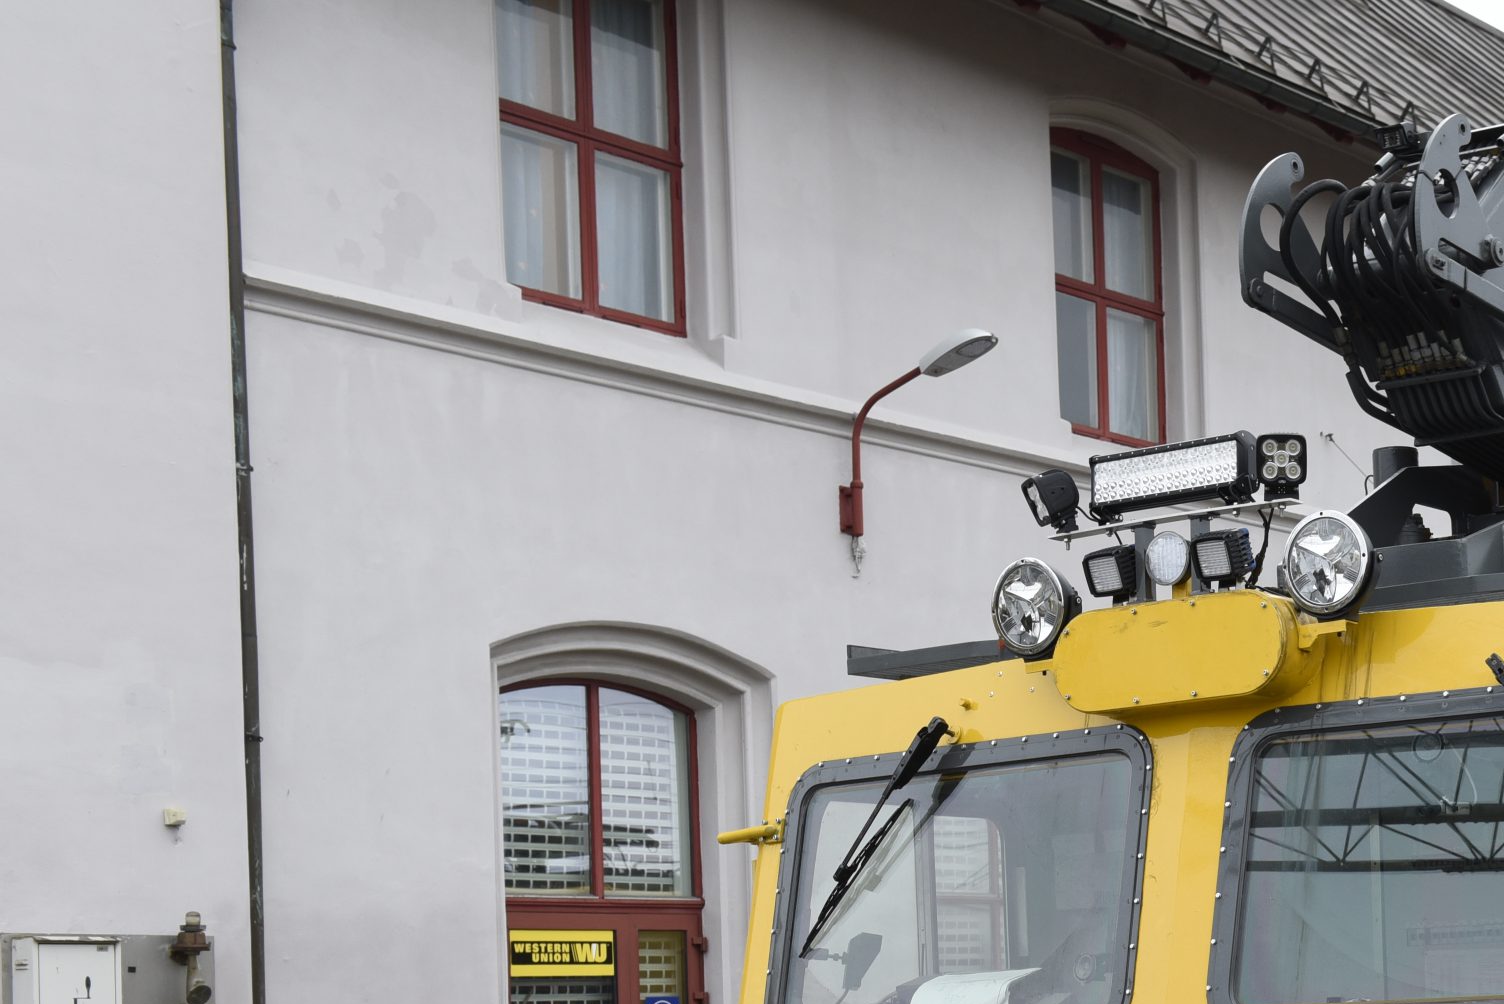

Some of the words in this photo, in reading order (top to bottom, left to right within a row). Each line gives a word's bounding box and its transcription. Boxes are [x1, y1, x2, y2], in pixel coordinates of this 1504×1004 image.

[514, 943, 570, 953] WESTERN
[575, 943, 608, 963] WU
[531, 953, 570, 963] UNION
